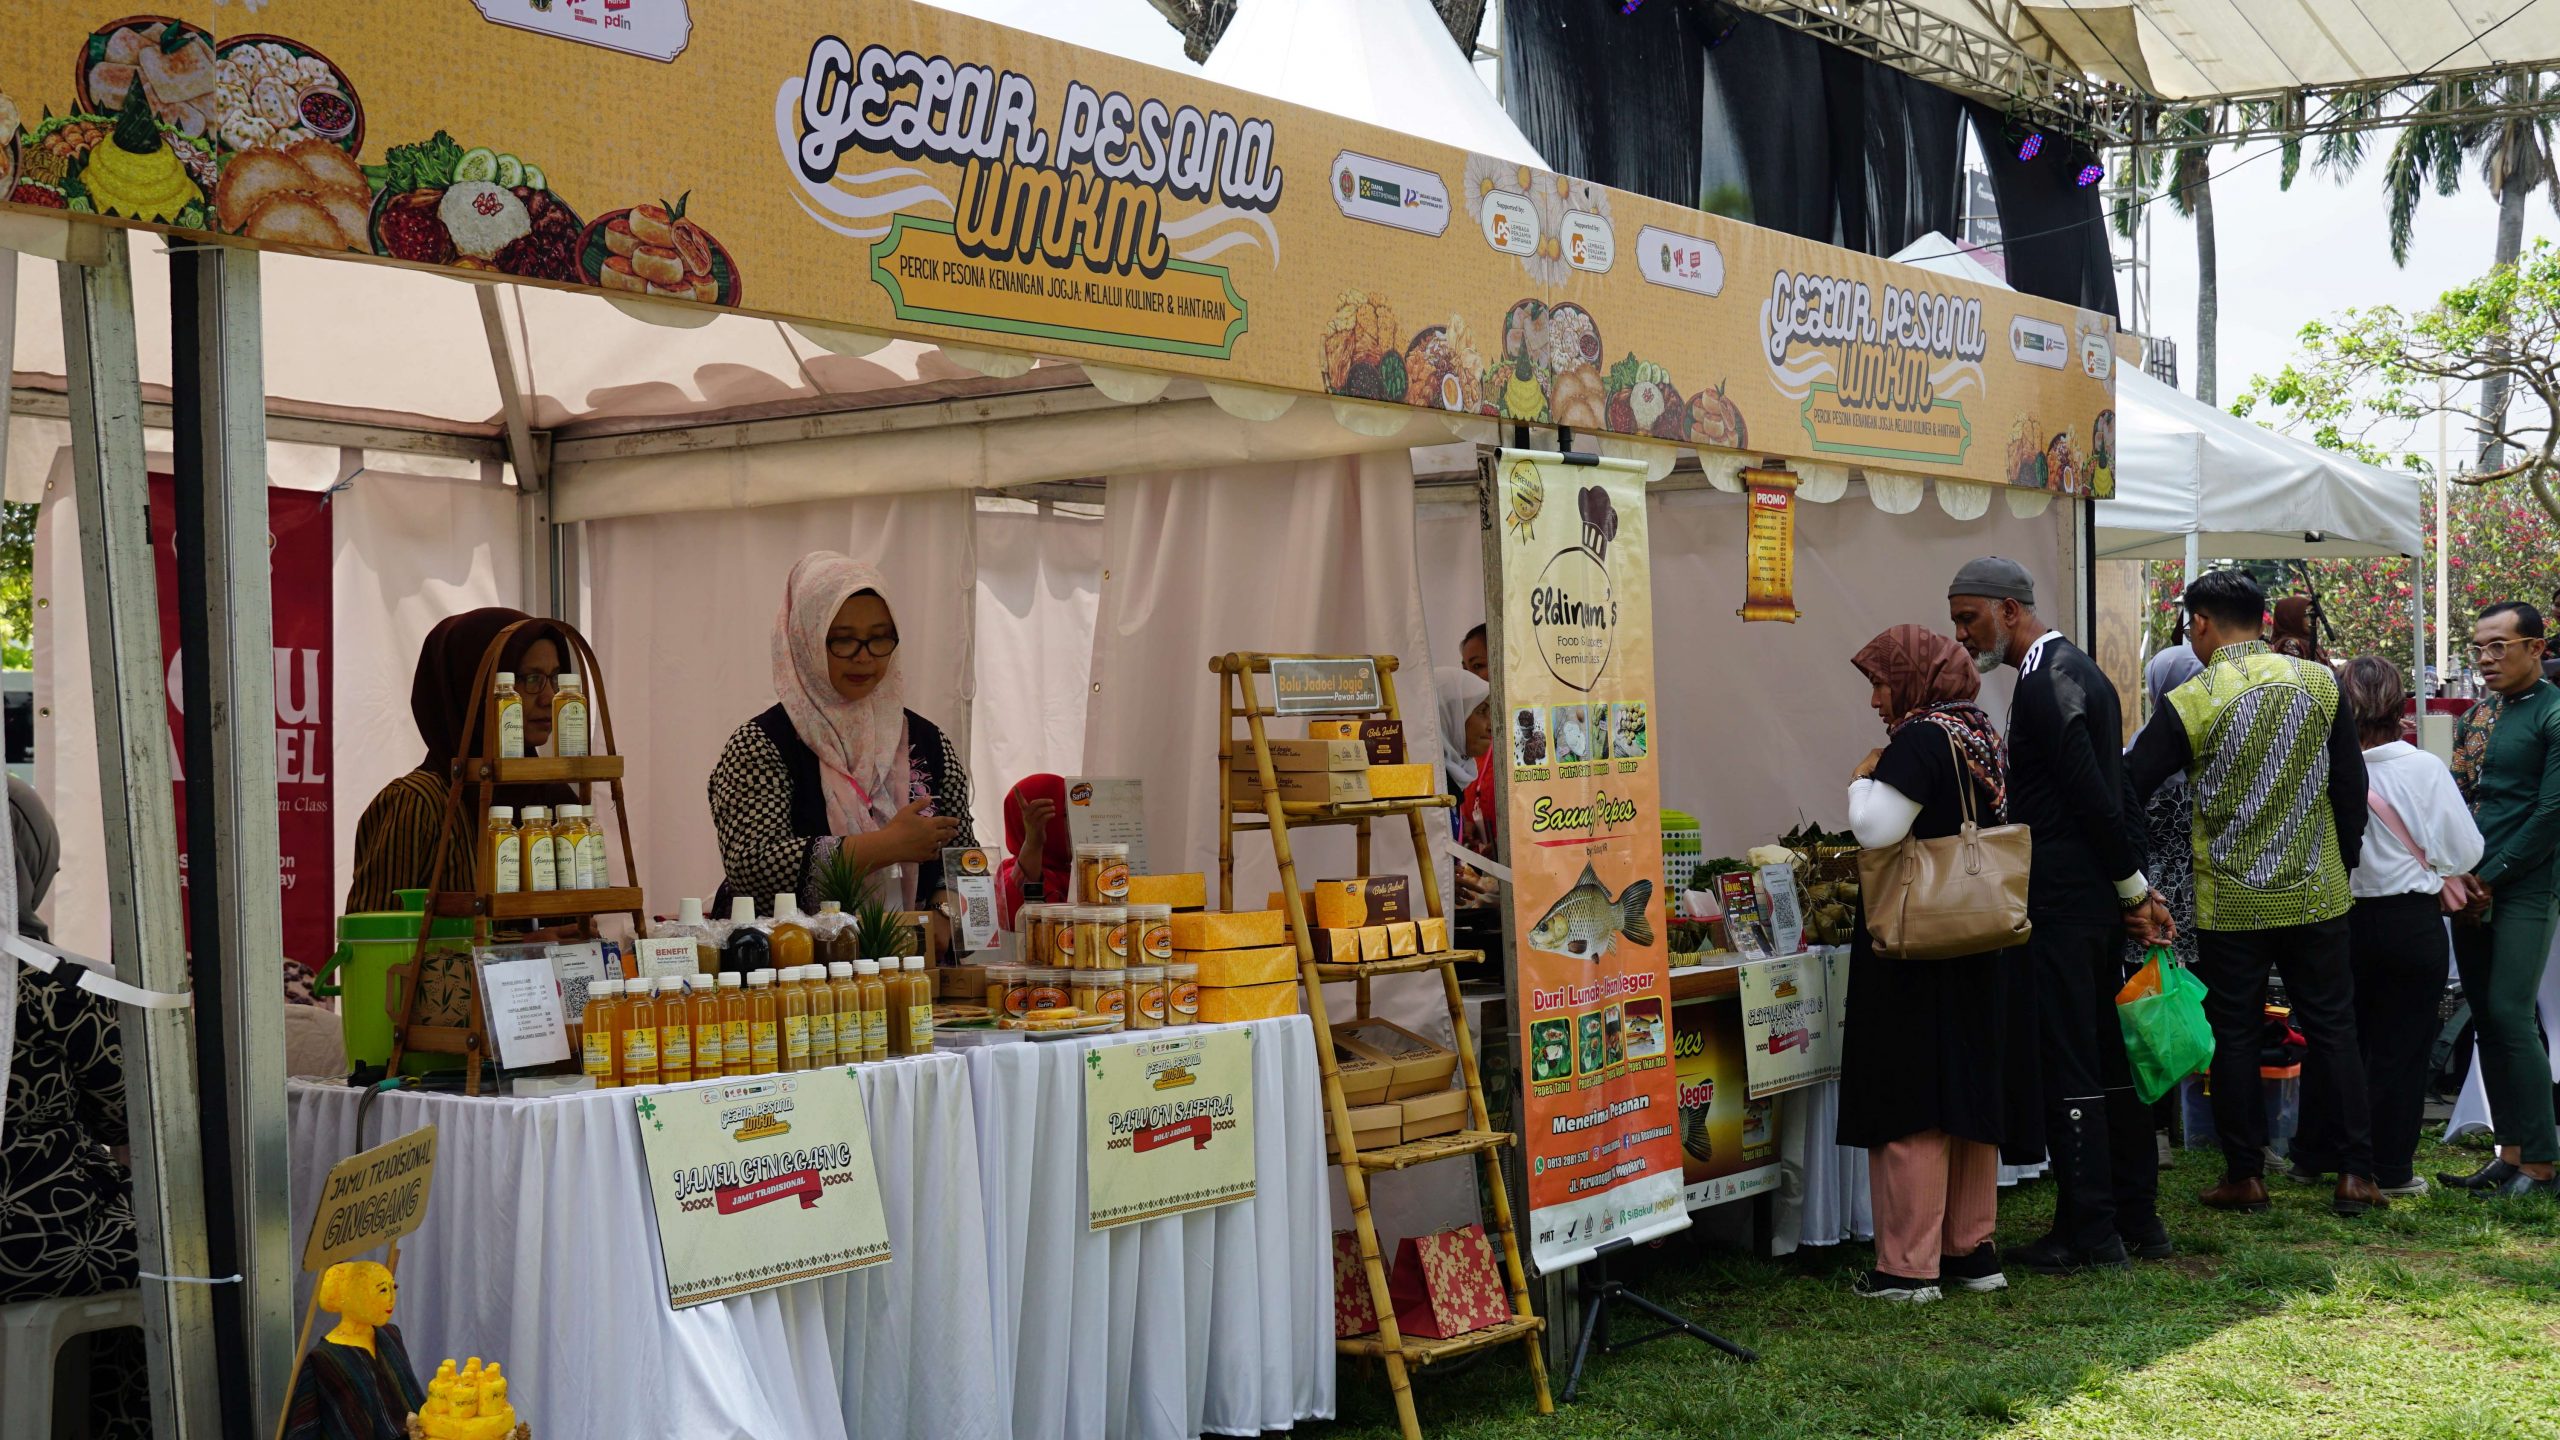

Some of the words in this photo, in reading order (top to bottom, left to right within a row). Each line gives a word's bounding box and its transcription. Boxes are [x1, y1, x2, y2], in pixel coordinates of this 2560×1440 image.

[604, 14, 631, 30] pdin
[1496, 200, 1518, 212] Supported
[955, 159, 1170, 278] UMKM
[1574, 221, 1593, 231] Supported
[900, 254, 940, 282] PERCIK
[943, 261, 986, 289] PESONA
[989, 268, 1044, 297] KENANGAN
[1084, 283, 1123, 307] MELALUI
[1125, 288, 1164, 313] KULINER
[1167, 294, 1175, 315] &
[1177, 295, 1227, 321] HANTARAN
[1837, 341, 1935, 414] UMKM
[1813, 408, 1832, 425] PERCIK
[1832, 410, 1853, 427] PESONA
[1756, 492, 1787, 506] PROMO
[1279, 675, 1301, 692] Bolu
[1304, 673, 1336, 692] Jadoel
[1338, 673, 1363, 695] Jogja
[1334, 691, 1355, 702] Pawon
[1514, 769, 1532, 783] Choco
[1532, 768, 1551, 781] Chips
[1559, 766, 1578, 779] Putri
[294, 797, 328, 813] Class
[1071, 790, 1090, 801] Safira
[1532, 795, 1596, 837] Saung
[1596, 789, 1637, 832] Pepes
[655, 947, 689, 956] BENEFIT
[1533, 986, 1565, 1013] Duri
[1534, 1084, 1554, 1099] Pepes
[1554, 1081, 1571, 1095] Tahu
[1679, 1082, 1715, 1109] Segar
[1108, 1104, 1173, 1135] PAWON
[1173, 1094, 1235, 1125] SAFIRA
[1552, 1108, 1610, 1135] Menerima
[1609, 1095, 1651, 1121] Pesanan
[1153, 1131, 1170, 1143] BOLU
[330, 1169, 367, 1202] JAMU
[369, 1139, 433, 1189] TRADISIONAL
[673, 1159, 740, 1201] JAMU
[738, 1142, 852, 1187] GINGGANG
[1616, 1157, 1647, 1179] Yogyakarta
[732, 1192, 756, 1207] JAMU
[756, 1176, 807, 1199] TRADISIONAL
[1686, 1191, 1697, 1201] PIRT
[322, 1177, 422, 1251] GINGGANG
[1627, 1204, 1654, 1221] SiBakul
[1654, 1196, 1676, 1215] Jogja
[1540, 1230, 1555, 1244] PIRT
